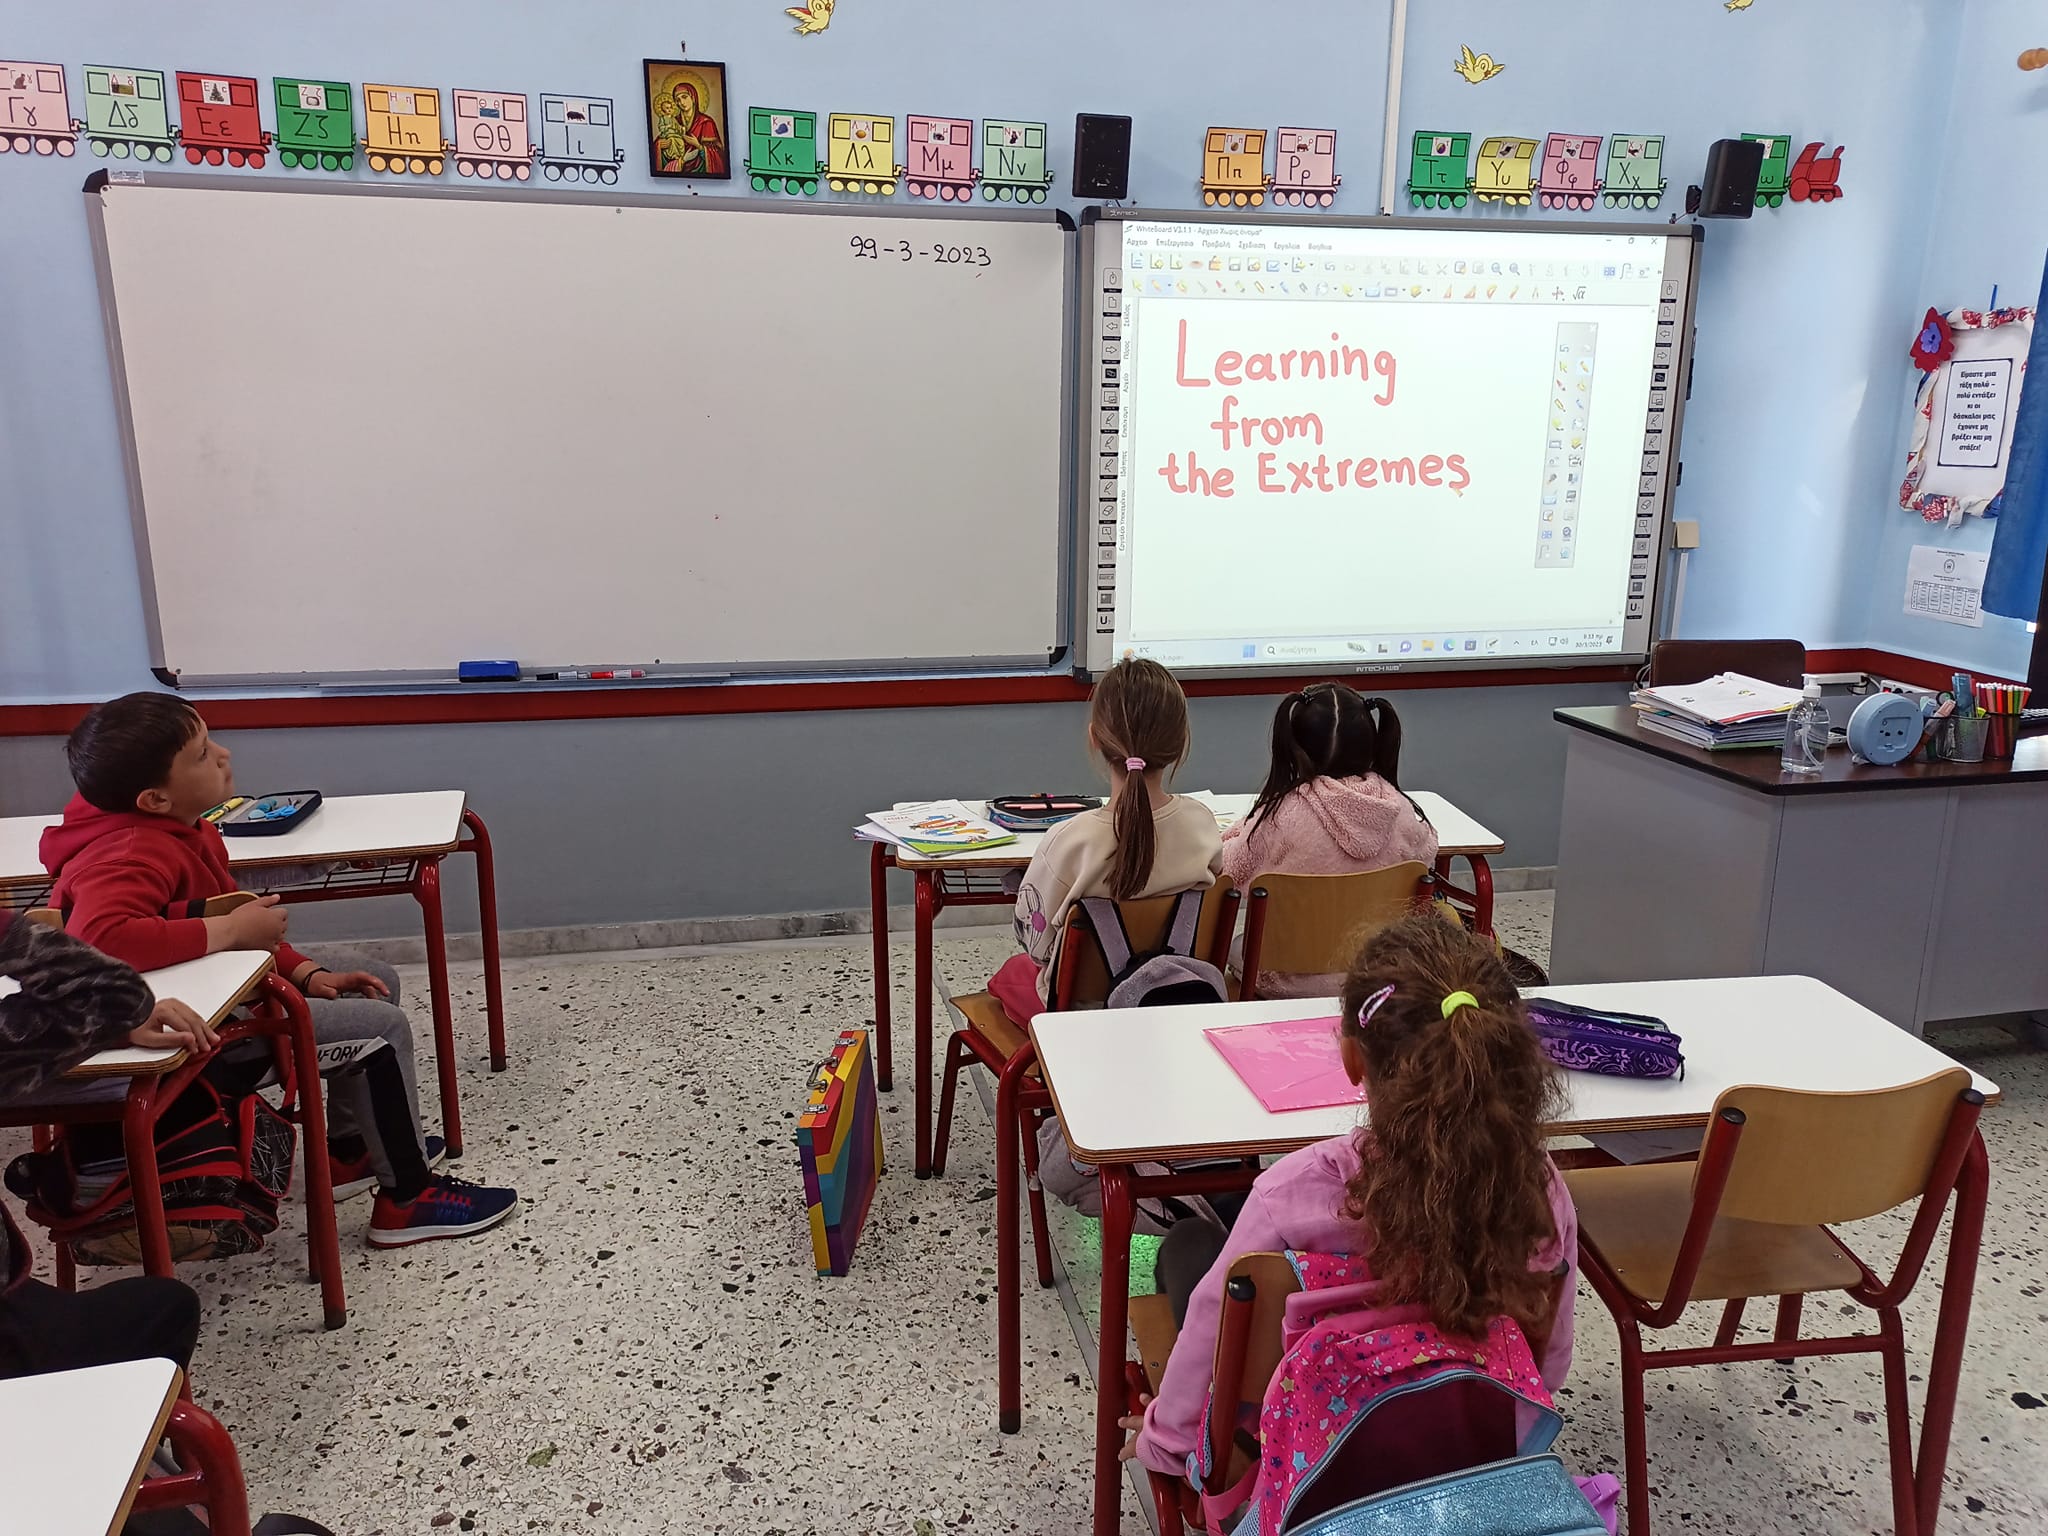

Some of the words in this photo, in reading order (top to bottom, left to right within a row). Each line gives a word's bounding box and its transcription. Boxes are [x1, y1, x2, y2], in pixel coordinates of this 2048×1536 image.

[1176, 318, 1397, 406] Learning
[1210, 395, 1323, 450] from
[1158, 451, 1234, 498] the
[1258, 452, 1471, 494] Extremes
